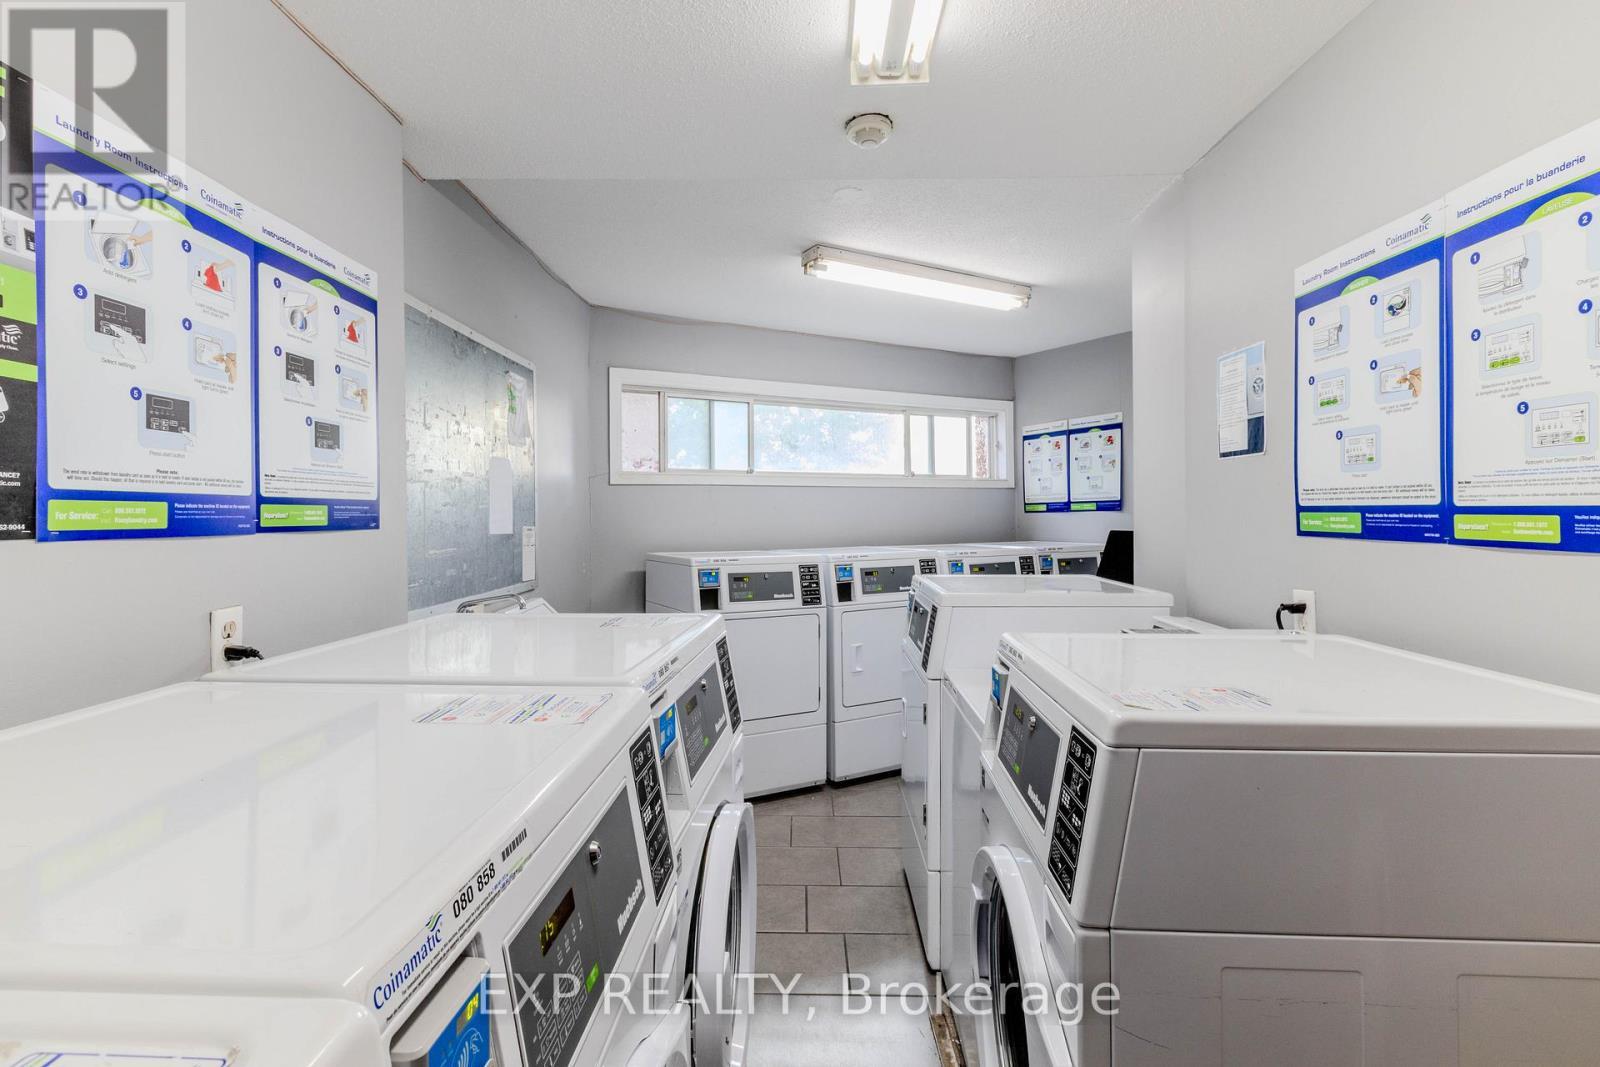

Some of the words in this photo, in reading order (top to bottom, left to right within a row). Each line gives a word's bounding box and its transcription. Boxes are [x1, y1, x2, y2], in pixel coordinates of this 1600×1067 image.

[56, 114, 100, 146] Laundry
[104, 140, 132, 162] Room
[135, 157, 188, 191] Instructions
[1456, 192, 1502, 218] Instructions
[1504, 183, 1524, 199] pour
[1526, 178, 1534, 187] la
[1536, 154, 1586, 182] buanderie
[200, 188, 242, 219] Coinamatic
[1386, 223, 1429, 247] Coinamatic
[1340, 248, 1376, 270] Instructions
[55, 512, 67, 520] For
[374, 929, 442, 1010] Coinamatic
[453, 886, 474, 918] 080
[477, 862, 495, 892] 858
